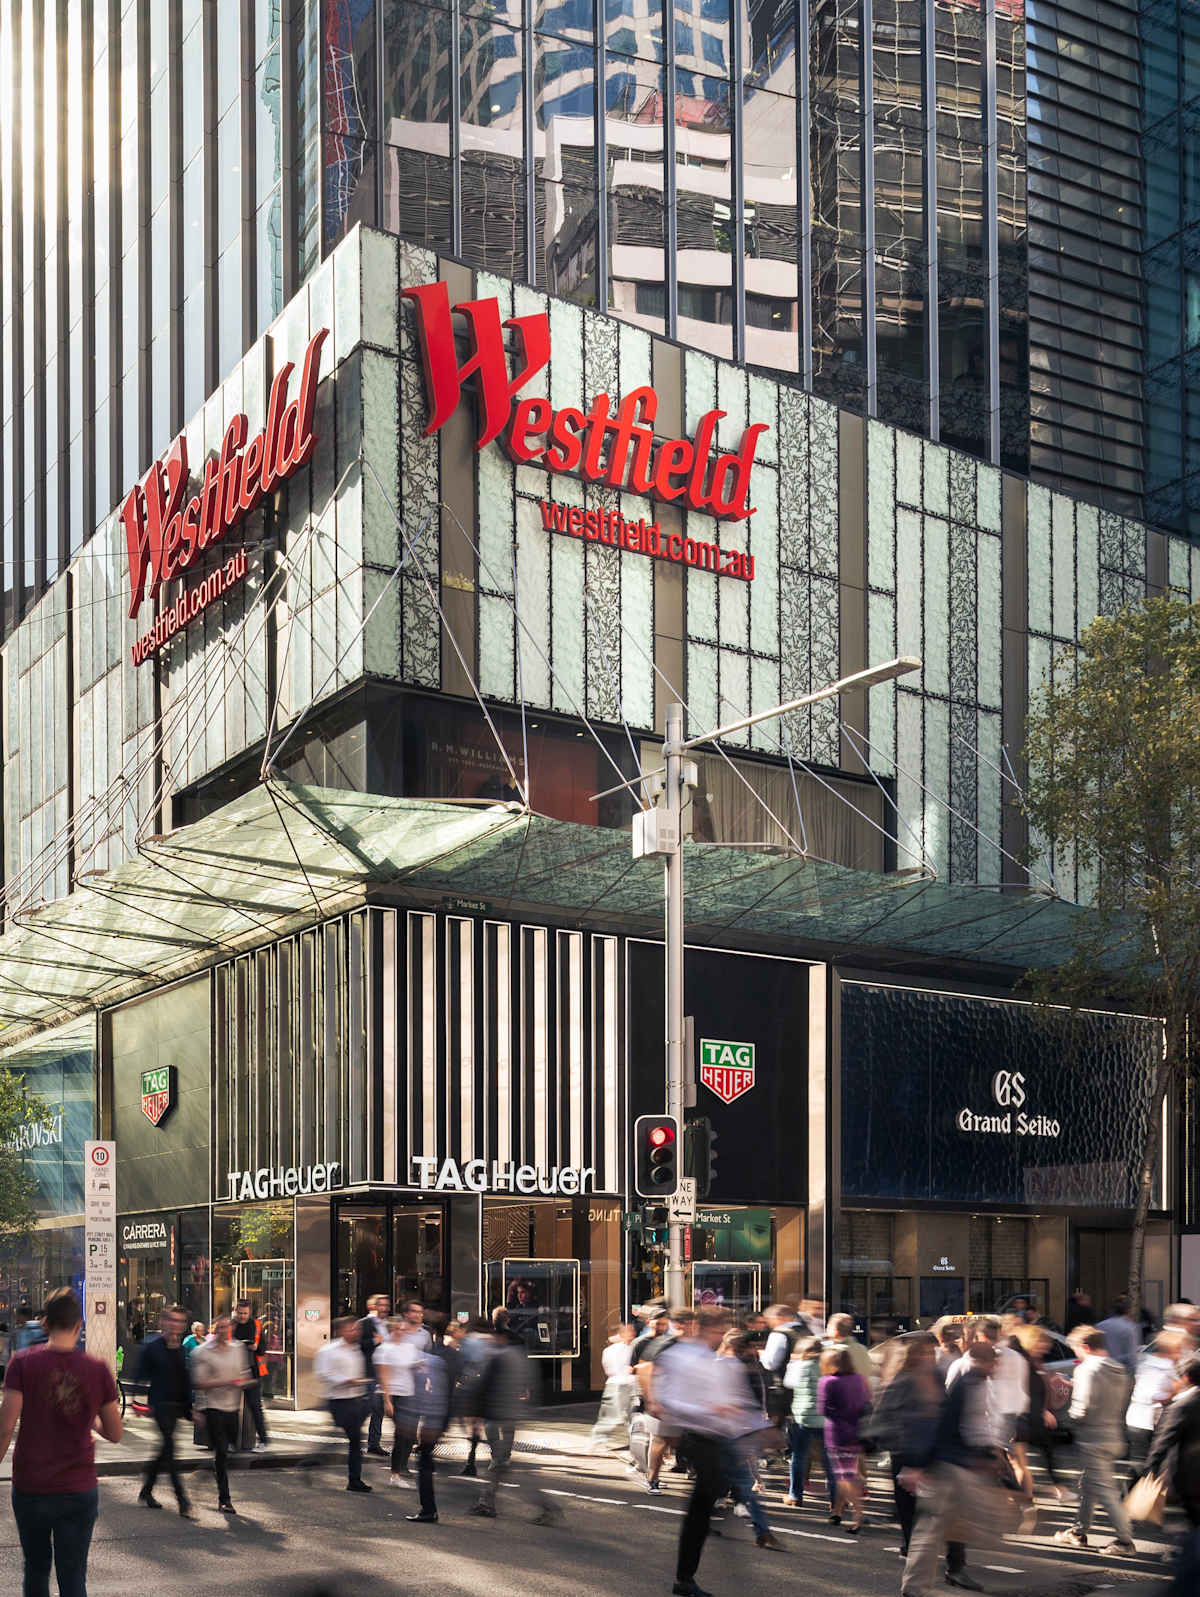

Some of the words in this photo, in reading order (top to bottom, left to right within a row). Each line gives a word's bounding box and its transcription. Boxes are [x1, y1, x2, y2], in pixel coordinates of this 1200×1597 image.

[400, 280, 770, 521] Westfield
[119, 328, 329, 620] Westfield
[540, 500, 755, 581] westfield.com.au
[131, 548, 248, 667] westfield.com.au
[704, 1044, 750, 1066] TAG
[143, 1071, 167, 1092] TAG
[703, 1068, 752, 1099] HEUER
[143, 1093, 168, 1121] HEUER
[958, 1107, 1011, 1133] Grand
[1016, 1112, 1061, 1138] Seiko
[96, 1151, 105, 1161] 10
[679, 1182, 692, 1192] NE
[671, 1195, 693, 1206] WAY
[695, 1212, 721, 1224] Market
[722, 1213, 732, 1224] St
[123, 1223, 167, 1241] CARRERA
[89, 1244, 98, 1257] P
